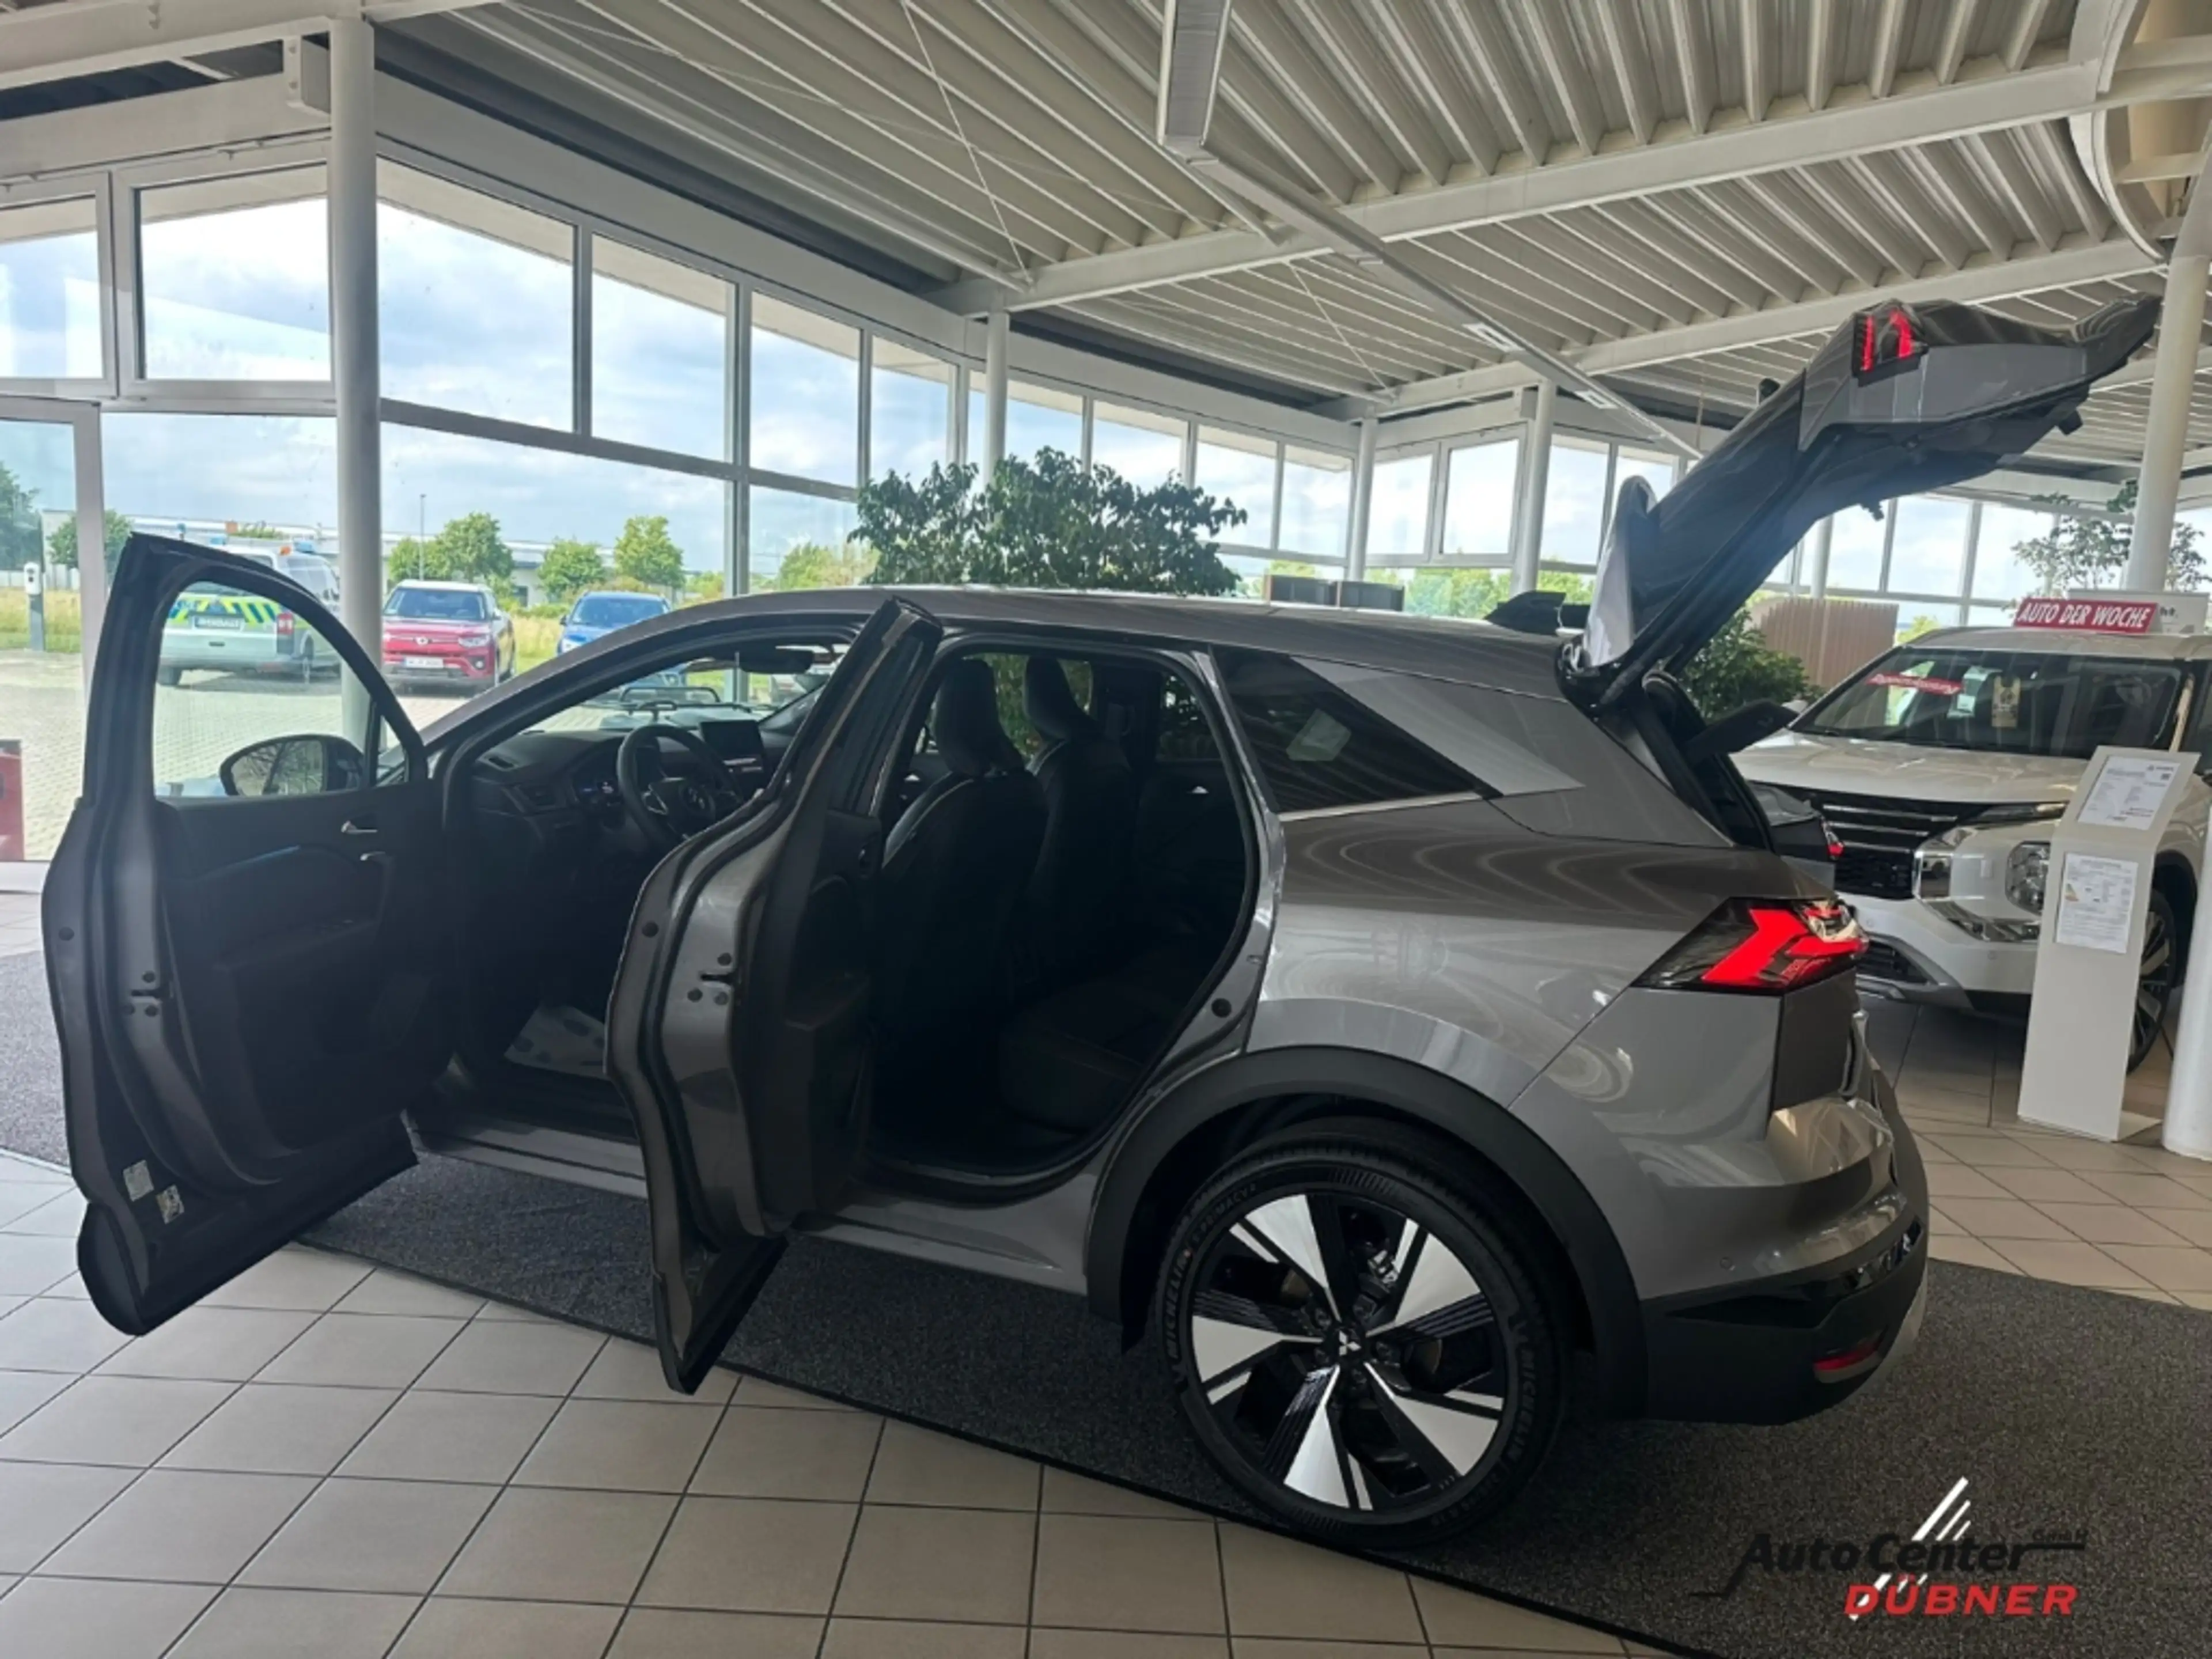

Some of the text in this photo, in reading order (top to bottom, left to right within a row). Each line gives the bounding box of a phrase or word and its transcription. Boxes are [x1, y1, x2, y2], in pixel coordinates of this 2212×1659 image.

[2018, 603, 2150, 627] AUTO DER WOCHE
[1165, 1255, 1188, 1359] MICHELIN
